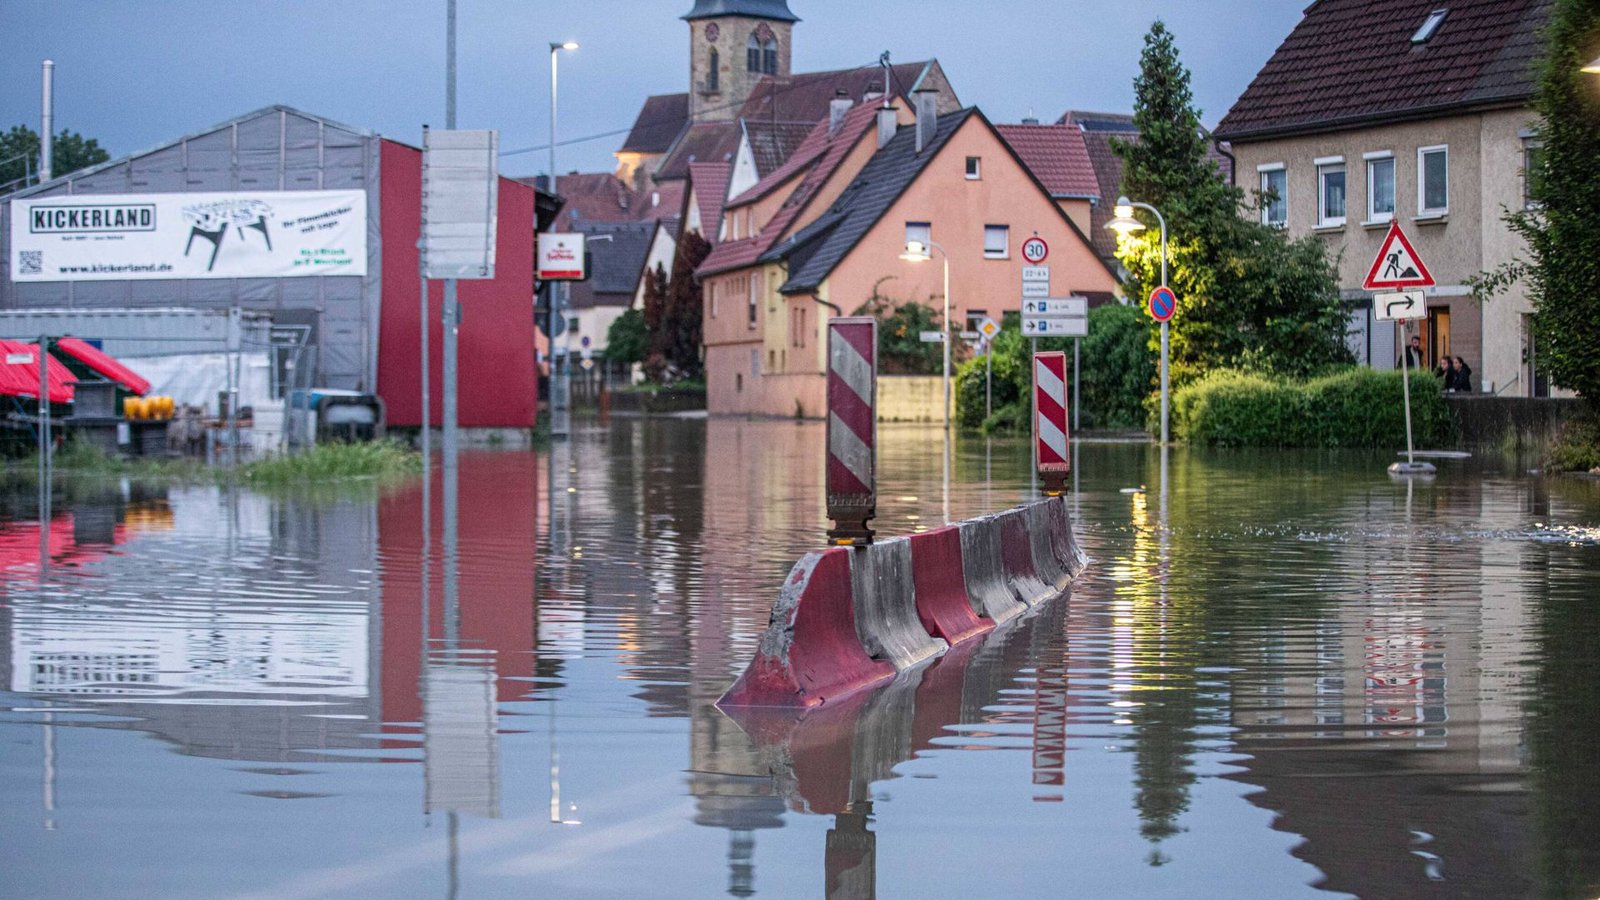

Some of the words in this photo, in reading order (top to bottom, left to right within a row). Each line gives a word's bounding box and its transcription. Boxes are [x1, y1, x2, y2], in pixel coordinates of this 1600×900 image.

[34, 208, 151, 229] KICKERLAND
[1027, 244, 1043, 257] 30
[59, 263, 173, 274] www.kickerland.de
